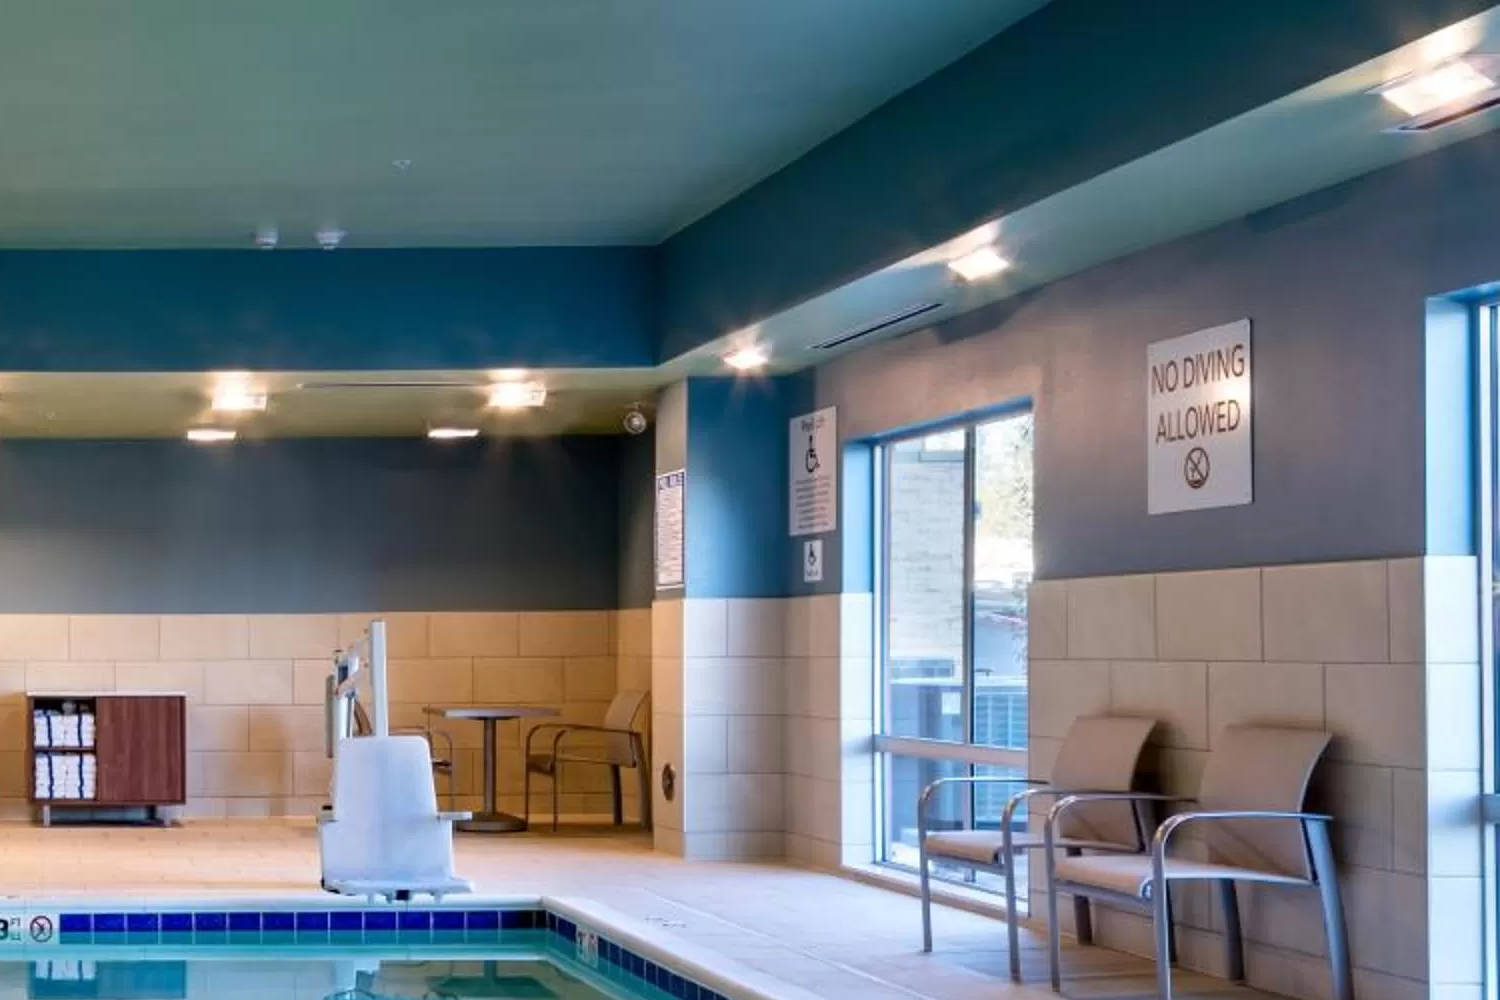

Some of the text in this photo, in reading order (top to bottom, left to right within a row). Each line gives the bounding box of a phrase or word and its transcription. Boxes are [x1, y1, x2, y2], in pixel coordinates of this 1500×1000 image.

[1152, 344, 1245, 397] NO DIVING
[1156, 399, 1241, 444] ALLOWED
